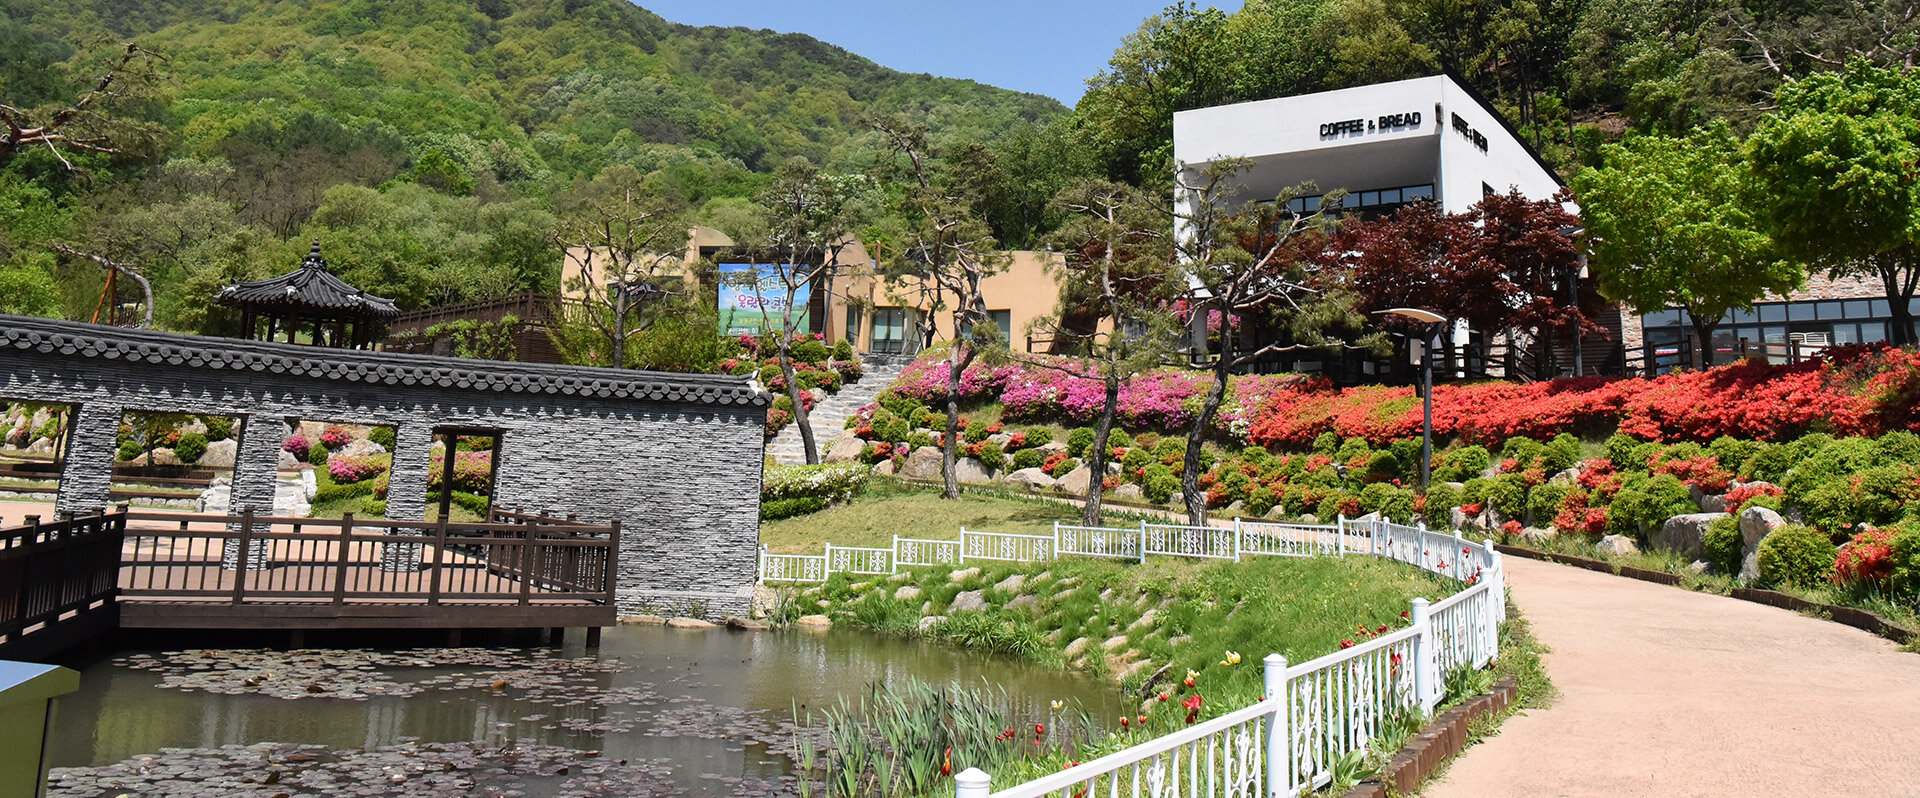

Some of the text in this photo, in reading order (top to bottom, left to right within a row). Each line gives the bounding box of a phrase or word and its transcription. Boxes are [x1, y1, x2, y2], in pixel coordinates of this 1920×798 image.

[1320, 111, 1422, 137] COFFEE & BREAD
